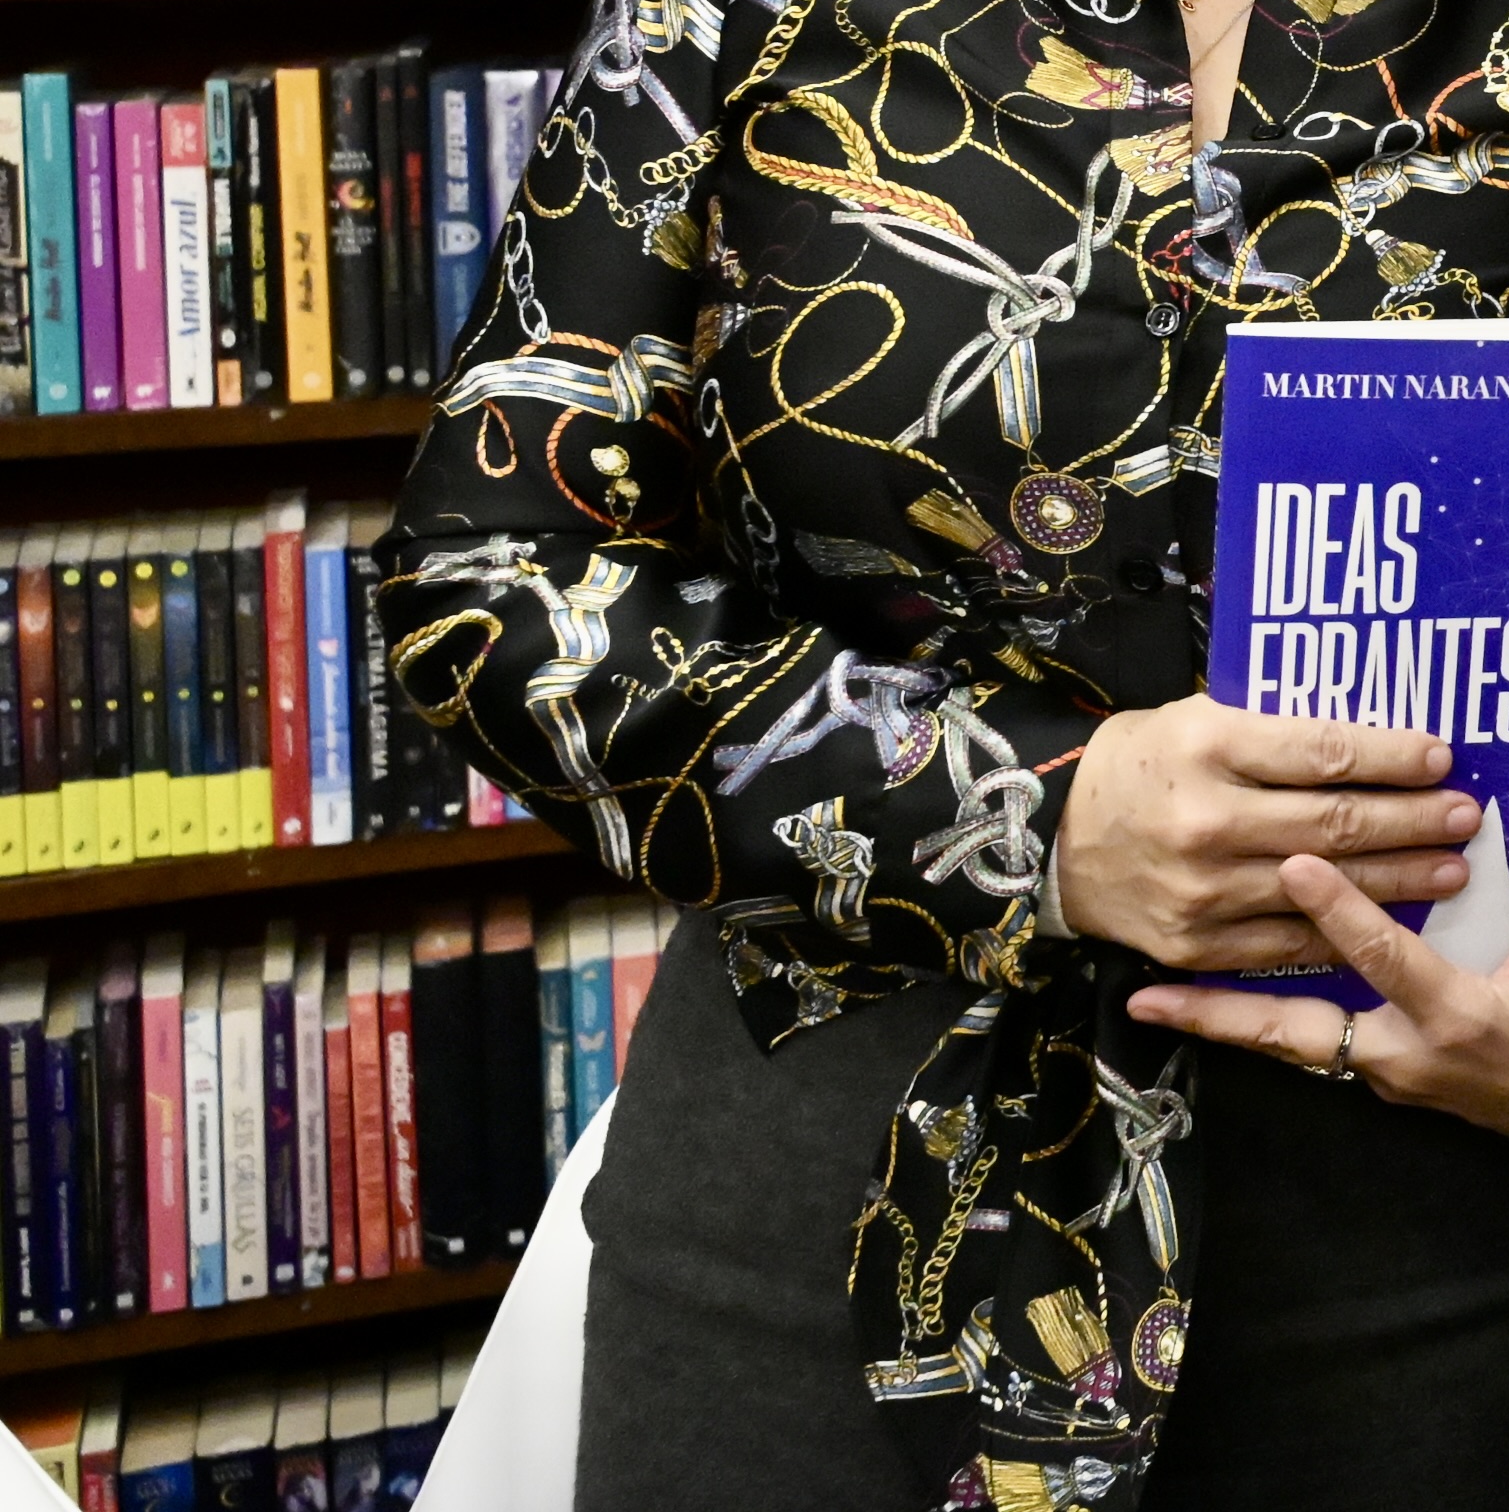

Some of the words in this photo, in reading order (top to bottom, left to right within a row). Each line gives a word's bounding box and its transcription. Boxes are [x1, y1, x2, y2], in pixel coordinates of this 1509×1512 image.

[170, 199, 200, 260] azul
[177, 263, 200, 337] Amor
[1262, 372, 1398, 399] MARTIN
[1251, 481, 1422, 617] IDEAS
